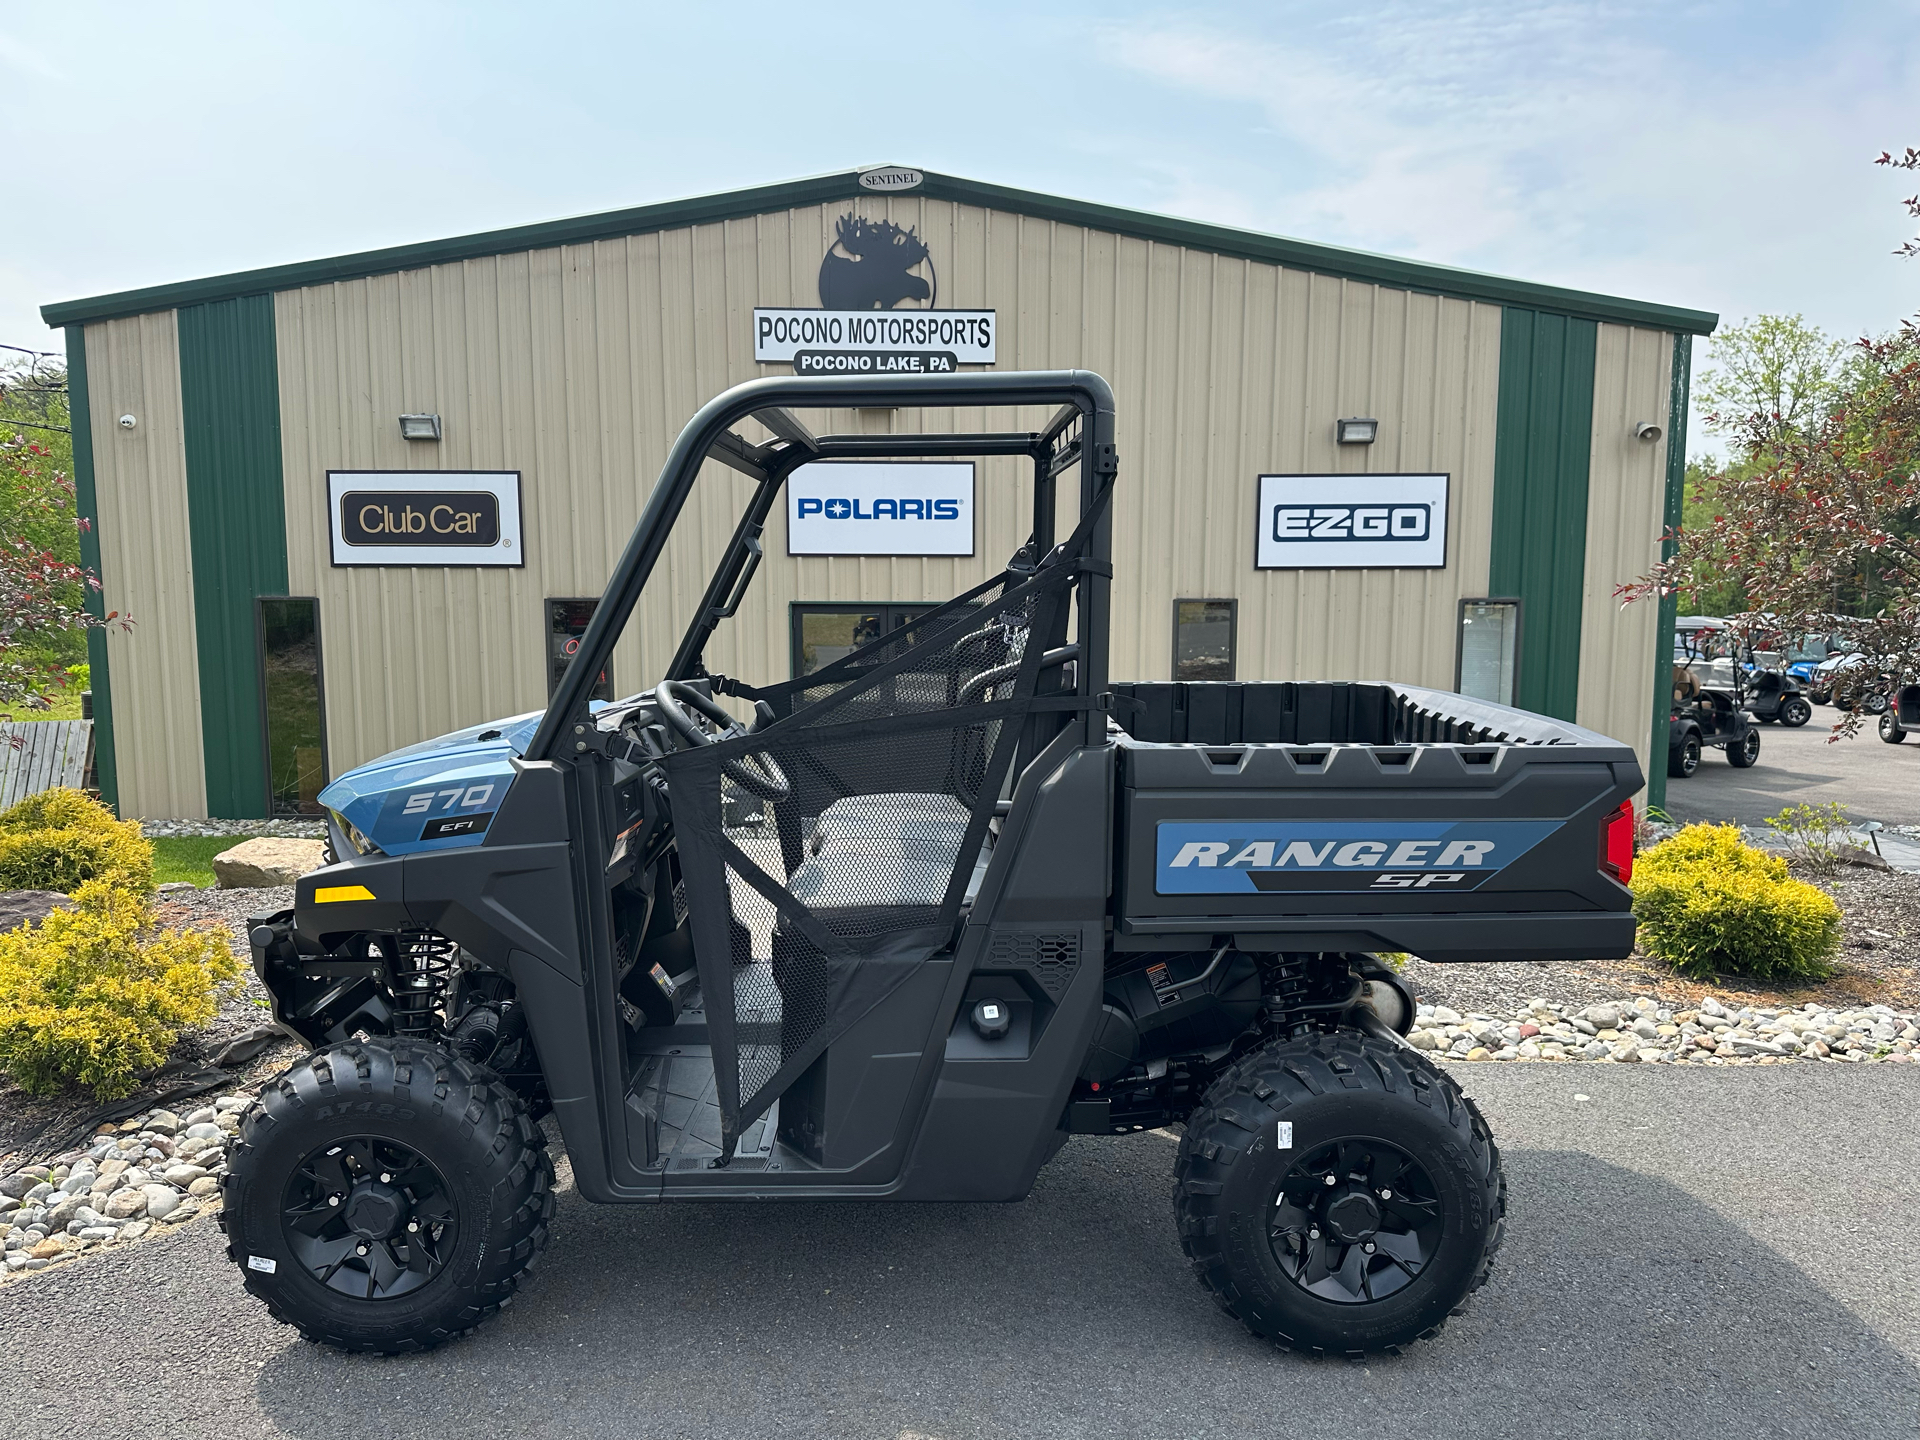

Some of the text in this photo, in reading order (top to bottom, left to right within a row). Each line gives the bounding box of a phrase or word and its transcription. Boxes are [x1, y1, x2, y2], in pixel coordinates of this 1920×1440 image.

[865, 173, 917, 186] SENTINEL
[759, 316, 991, 349] POCONO MOTORSPORTS
[801, 356, 950, 373] POCONO LAKE, PA
[359, 504, 481, 533] Club Car
[797, 498, 959, 520] POLARIS
[1277, 508, 1427, 538] EZGO
[402, 784, 495, 815] 570
[439, 820, 474, 832] EFI
[1168, 840, 1496, 868] RANGER
[1369, 873, 1466, 888] SP
